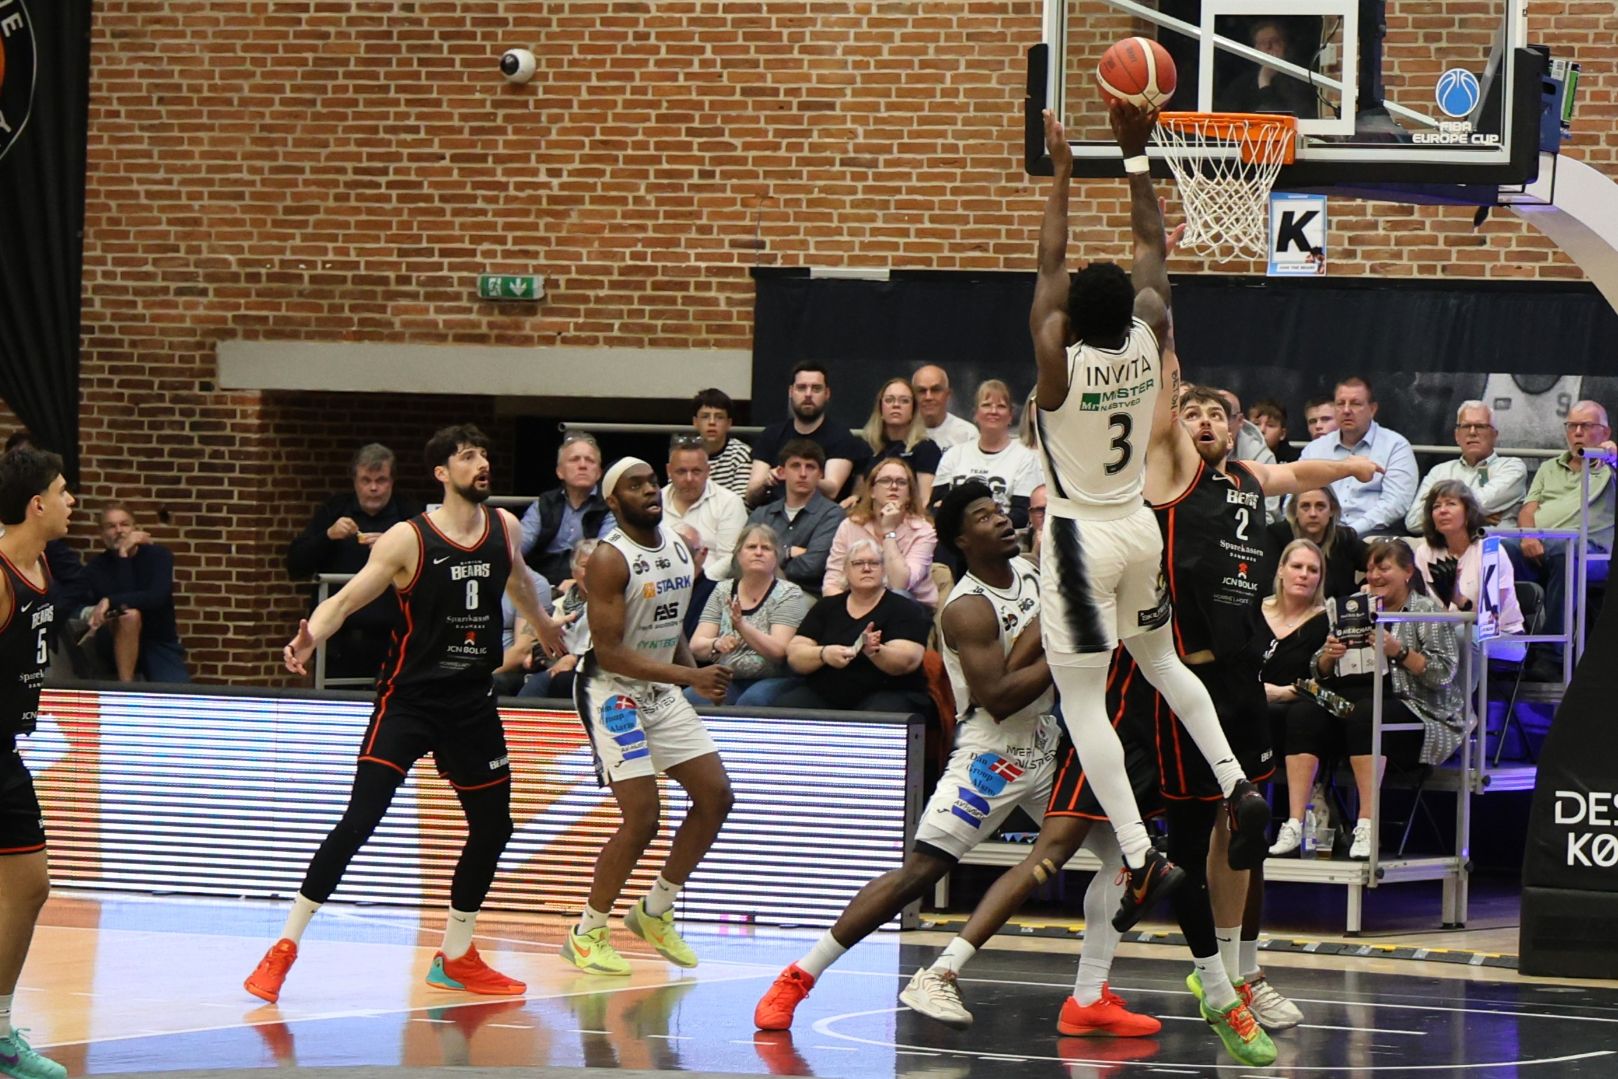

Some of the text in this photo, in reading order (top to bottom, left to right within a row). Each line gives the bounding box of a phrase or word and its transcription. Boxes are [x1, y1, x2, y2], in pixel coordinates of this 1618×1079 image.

[1412, 133, 1499, 144] EUROPE CUP
[1440, 121, 1472, 132] FIBA
[1276, 210, 1320, 253] K
[1087, 355, 1152, 387] INVITA
[1104, 412, 1133, 476] 3
[1234, 507, 1249, 541] 2
[450, 563, 491, 581] BEARS
[656, 575, 692, 594] STARK
[1480, 564, 1496, 613] K
[465, 579, 479, 610] 8
[36, 627, 47, 664] 5
[446, 645, 462, 653] JCN
[1555, 790, 1618, 826] DE
[1567, 832, 1618, 867] KØ
